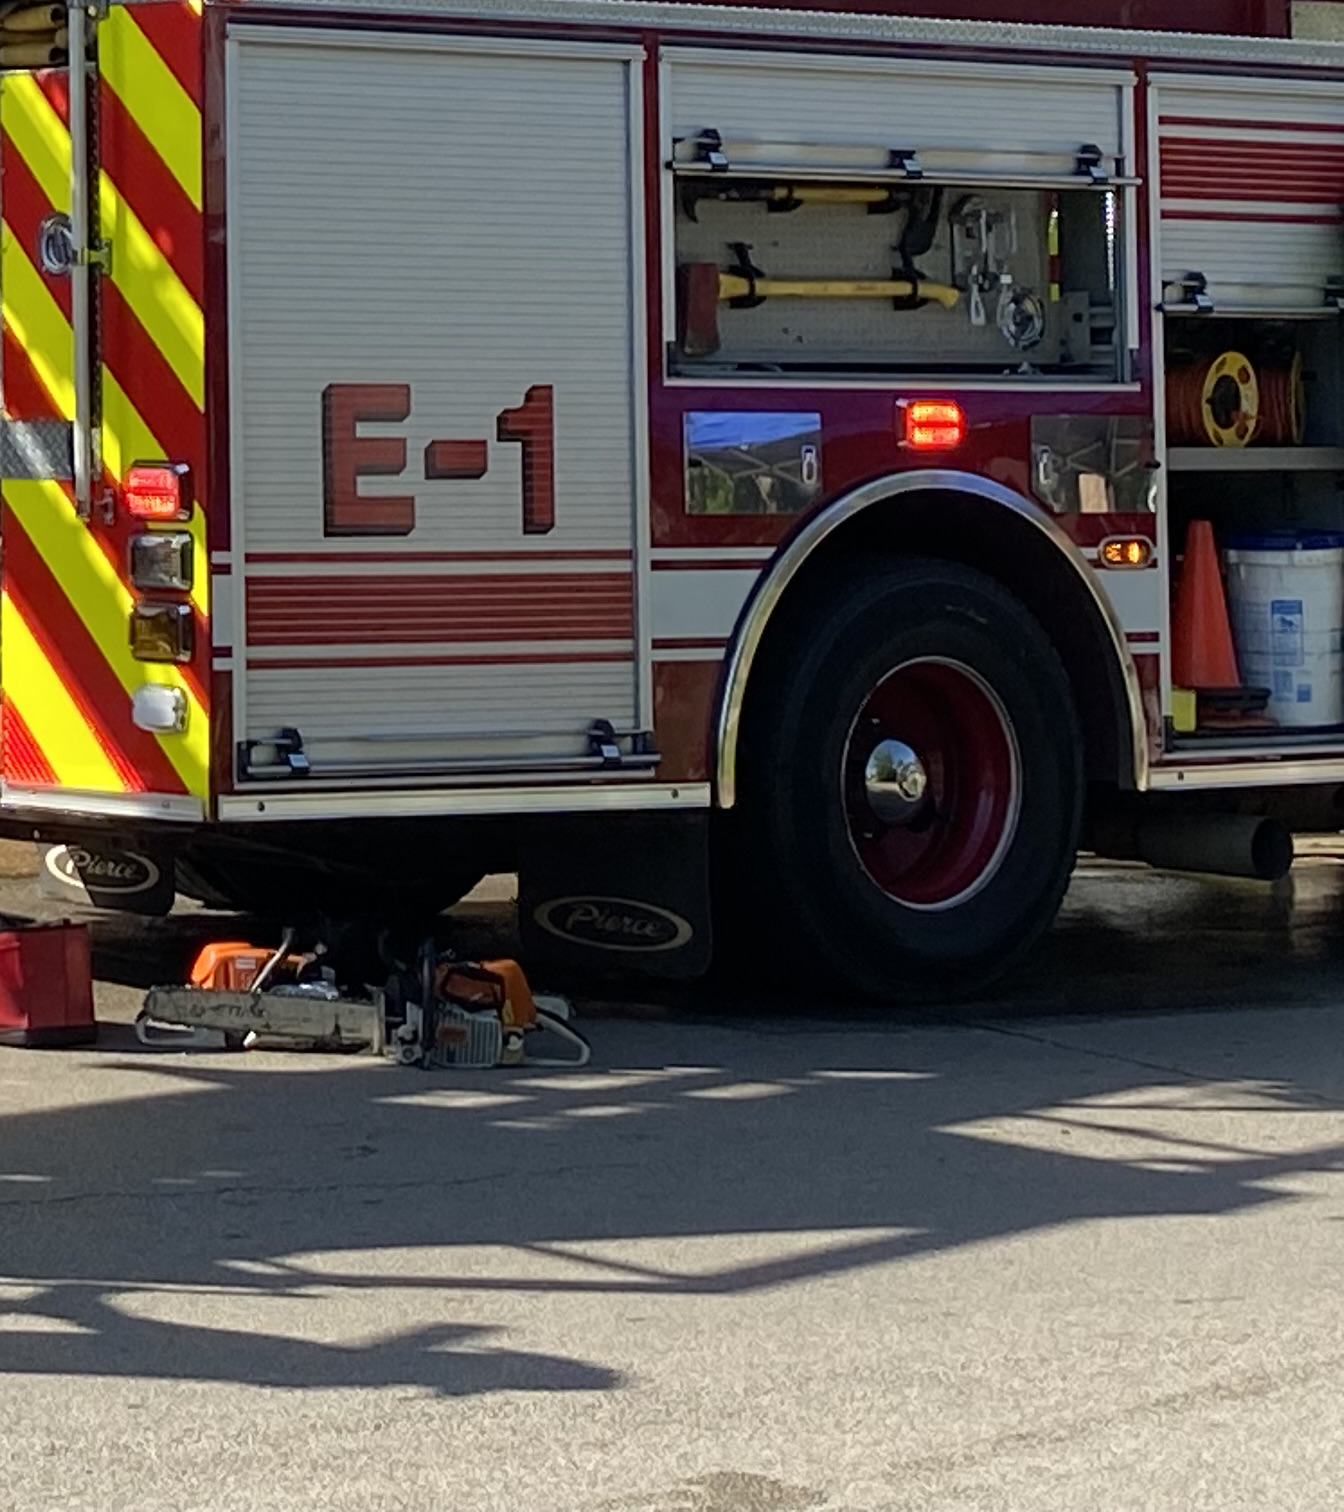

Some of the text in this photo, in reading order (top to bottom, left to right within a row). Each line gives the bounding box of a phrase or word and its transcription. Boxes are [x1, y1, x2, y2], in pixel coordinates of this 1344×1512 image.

[322, 383, 555, 537] E-1
[66, 849, 138, 879] Pierce
[565, 903, 660, 938] Pierce
